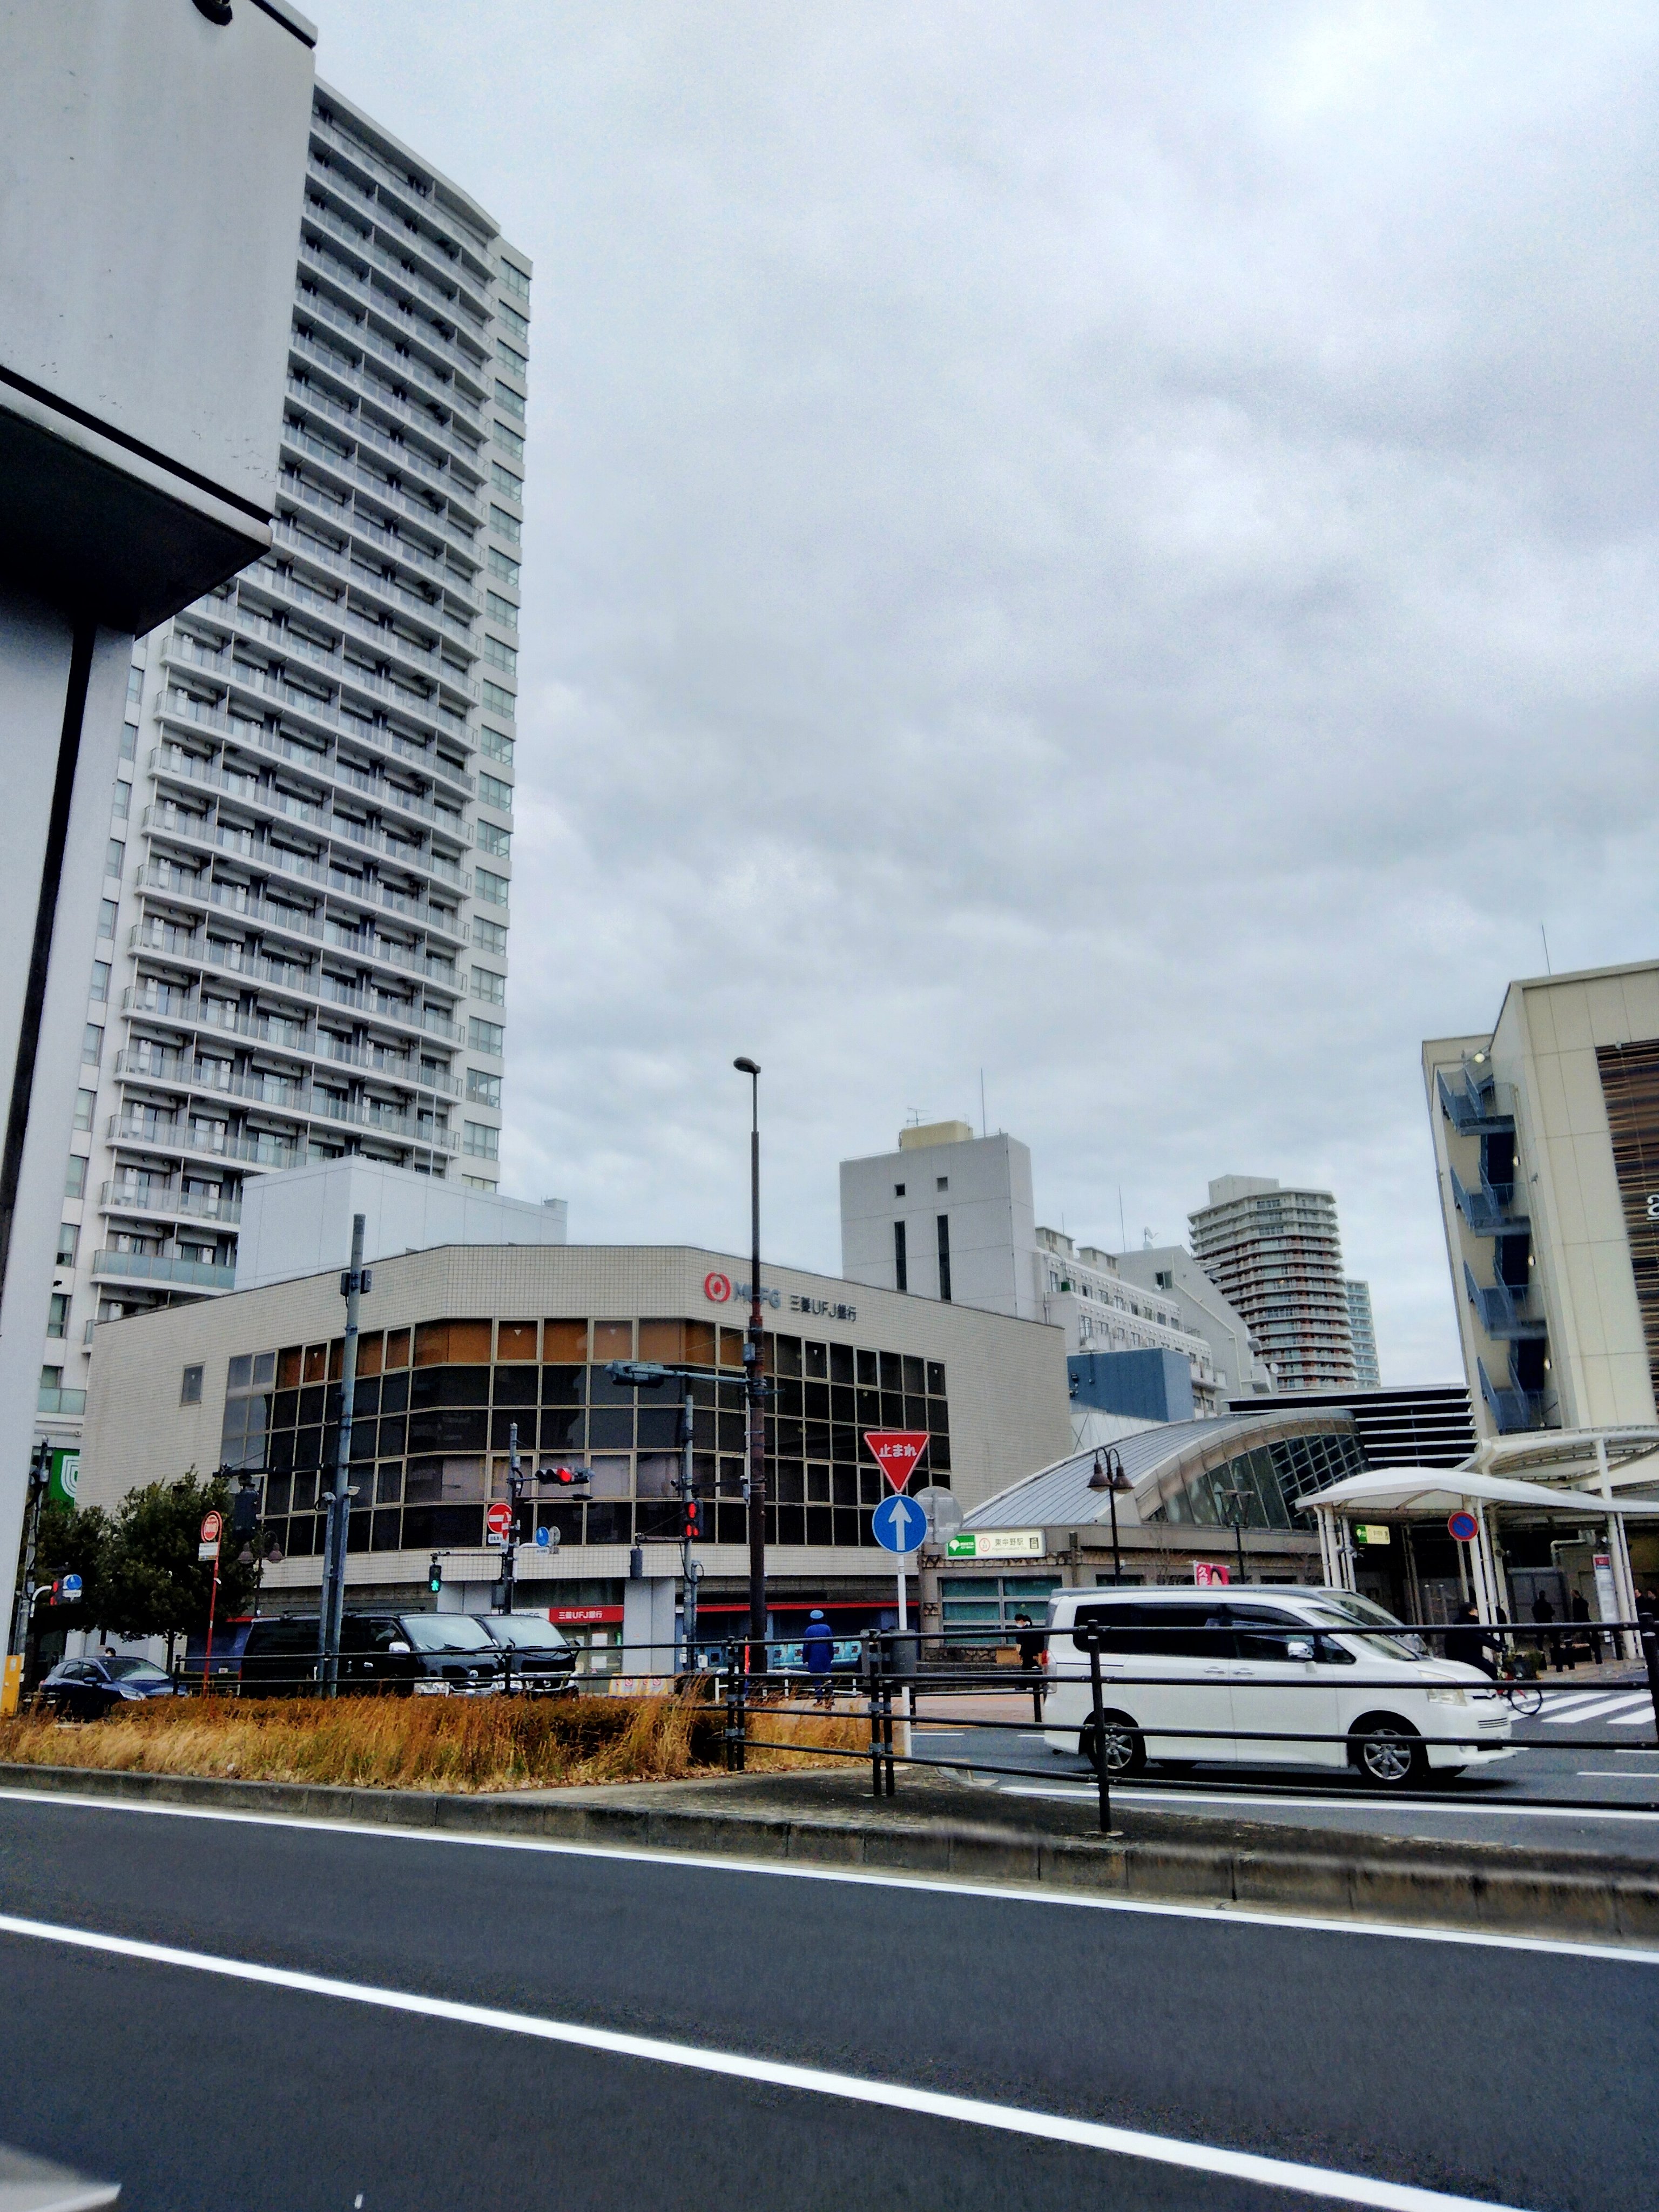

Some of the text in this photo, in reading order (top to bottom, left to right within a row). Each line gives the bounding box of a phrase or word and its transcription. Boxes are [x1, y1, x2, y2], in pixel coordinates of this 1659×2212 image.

[791, 1294, 857, 1322] 三菱UFJ銀行
[879, 1444, 918, 1458] 止まれ
[558, 1610, 603, 1620] 三菱UFJ銀行
